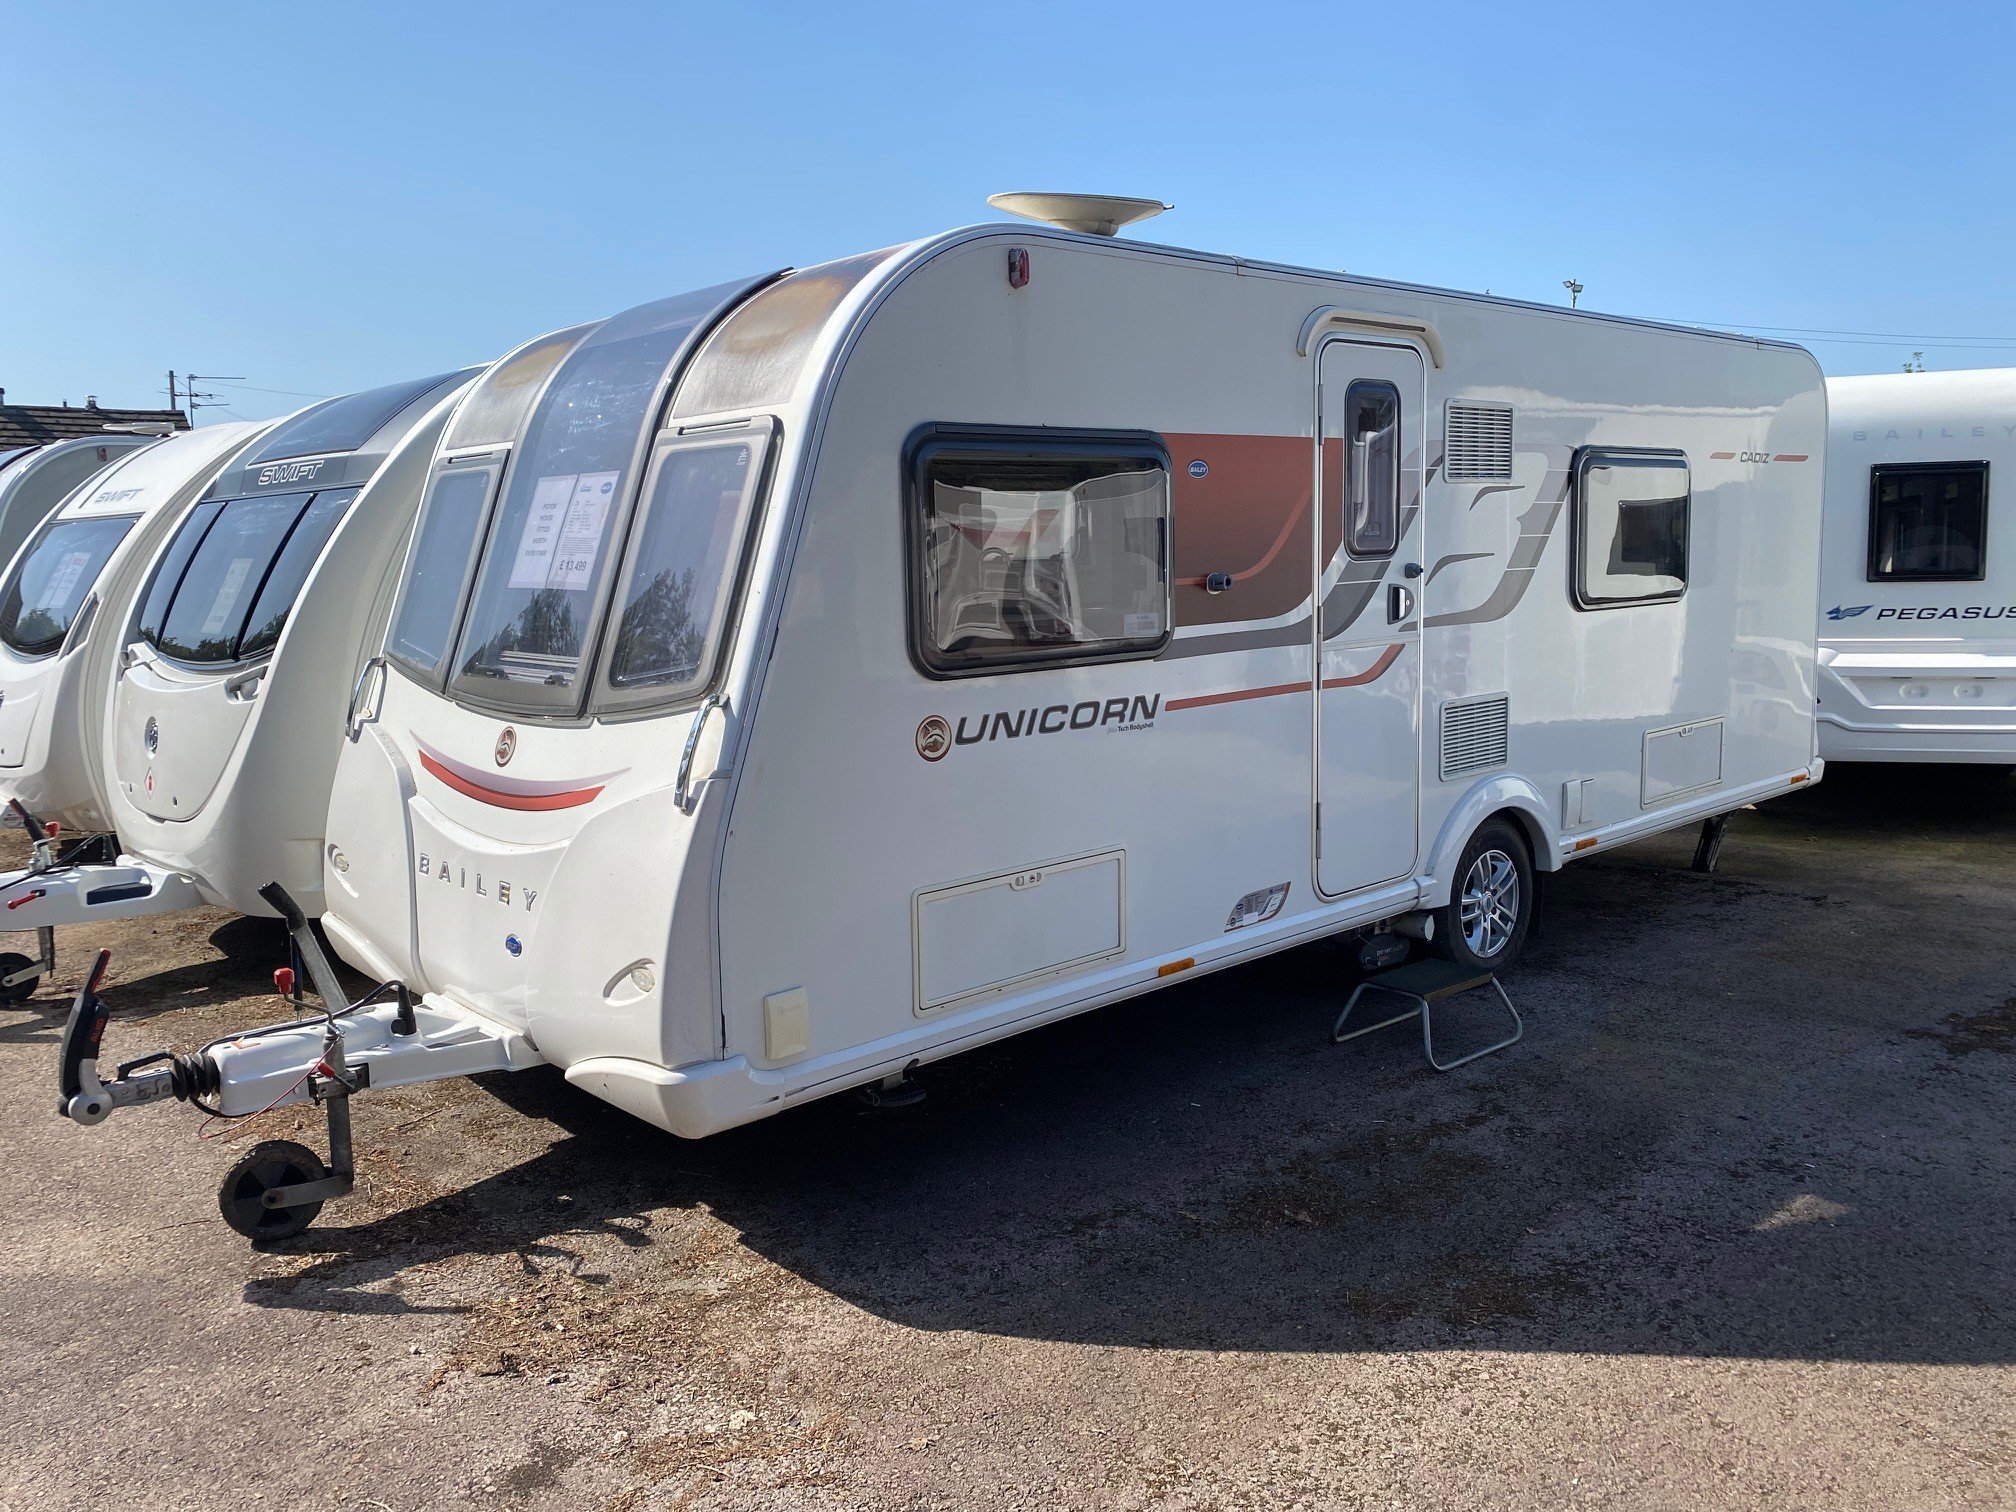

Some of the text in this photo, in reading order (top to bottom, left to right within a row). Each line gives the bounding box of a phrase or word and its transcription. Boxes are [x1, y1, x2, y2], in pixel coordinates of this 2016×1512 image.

[1853, 425, 2016, 442] BAILEY
[1740, 451, 1770, 464] CADIZ
[258, 460, 325, 486] SWIFT
[95, 487, 144, 504] SWIFT
[954, 693, 1161, 746] UNICORN
[418, 853, 538, 912] BAILEY
